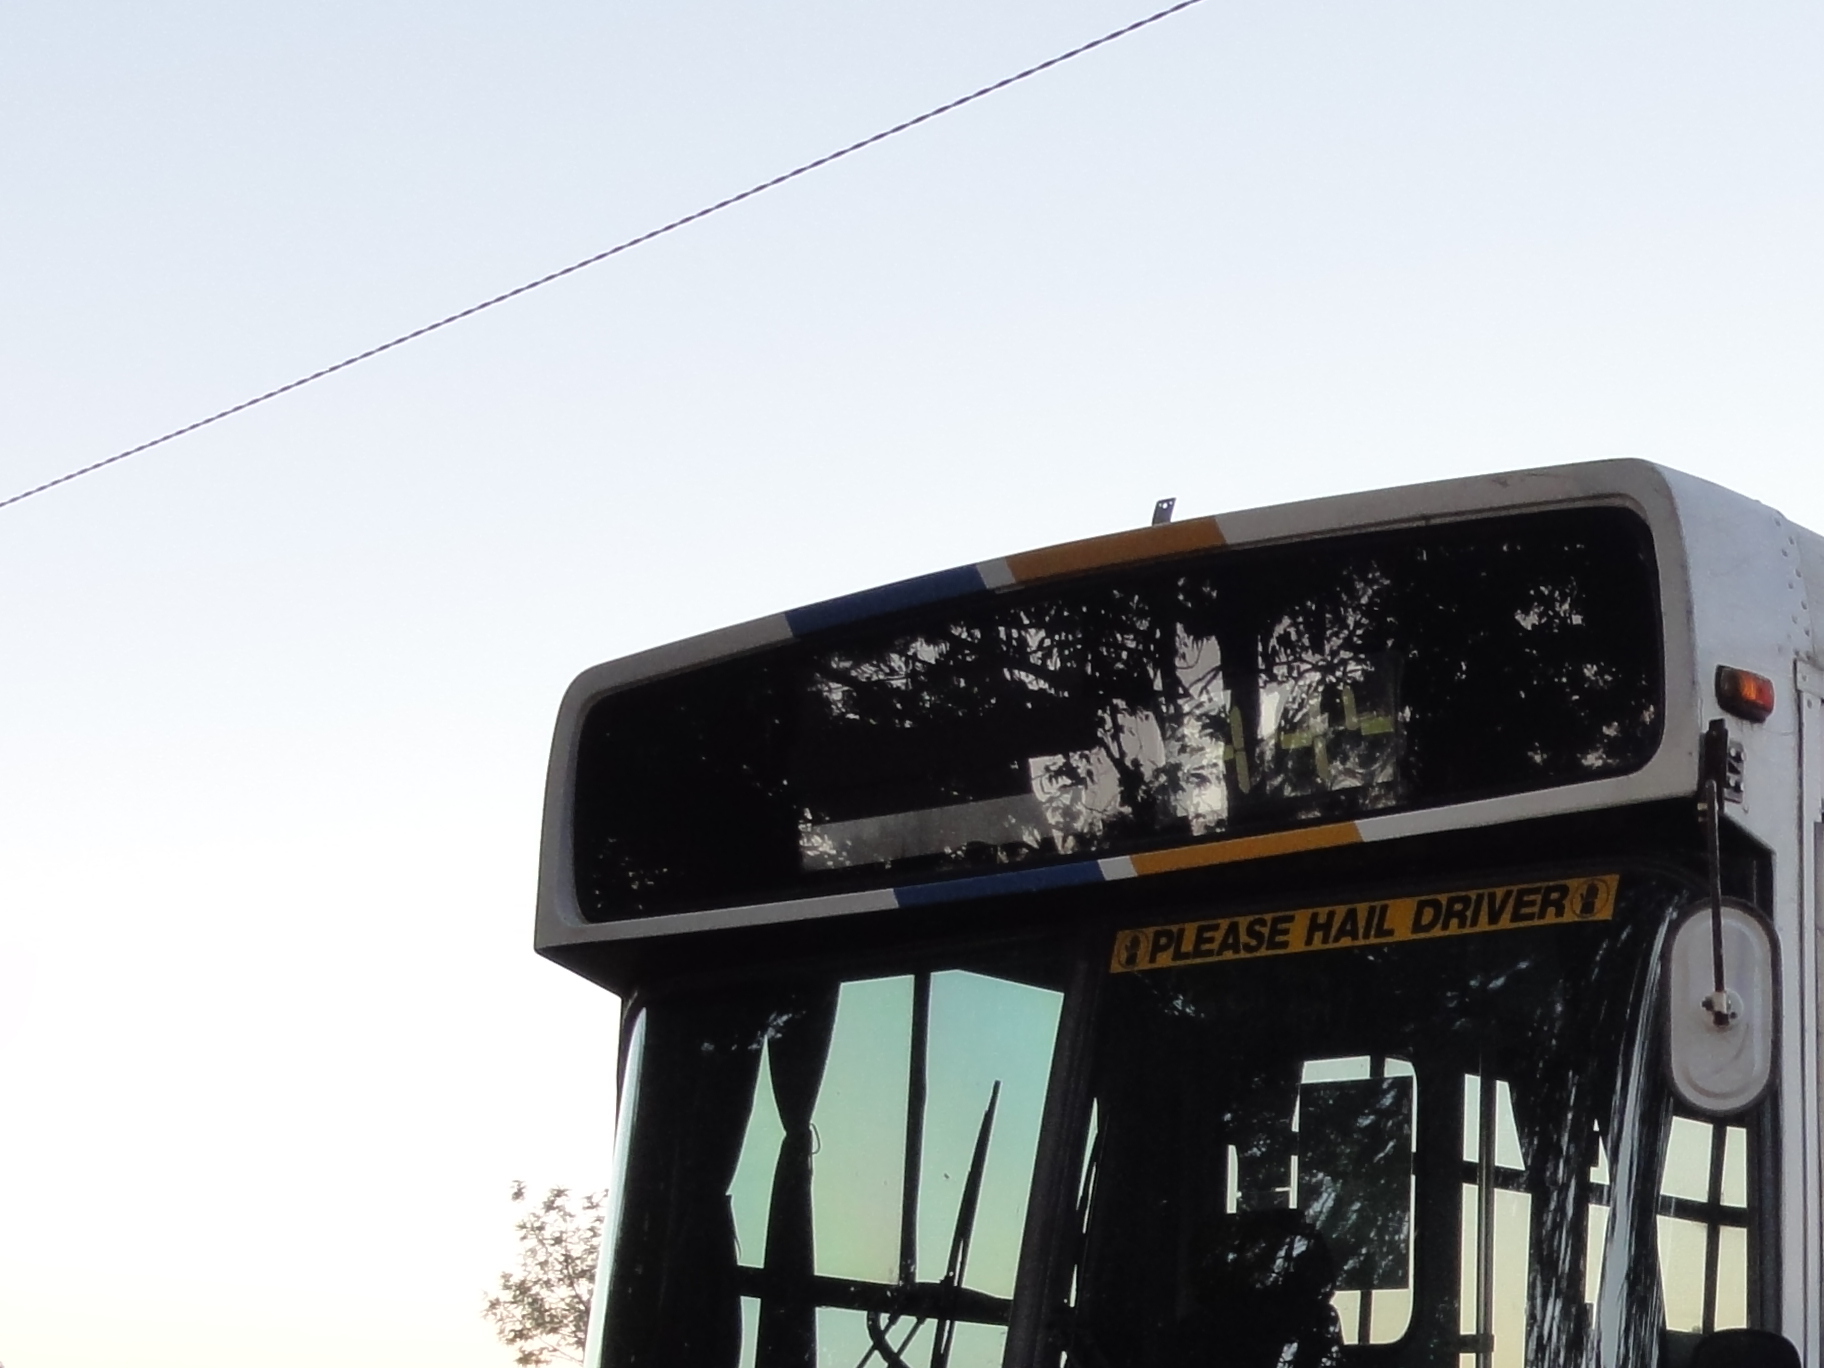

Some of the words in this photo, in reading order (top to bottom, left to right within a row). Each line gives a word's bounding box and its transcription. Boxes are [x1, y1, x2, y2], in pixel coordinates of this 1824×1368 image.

[1149, 914, 1296, 964] PLEASE
[1305, 903, 1395, 947] HAIL
[1413, 883, 1570, 935] DRIVER
